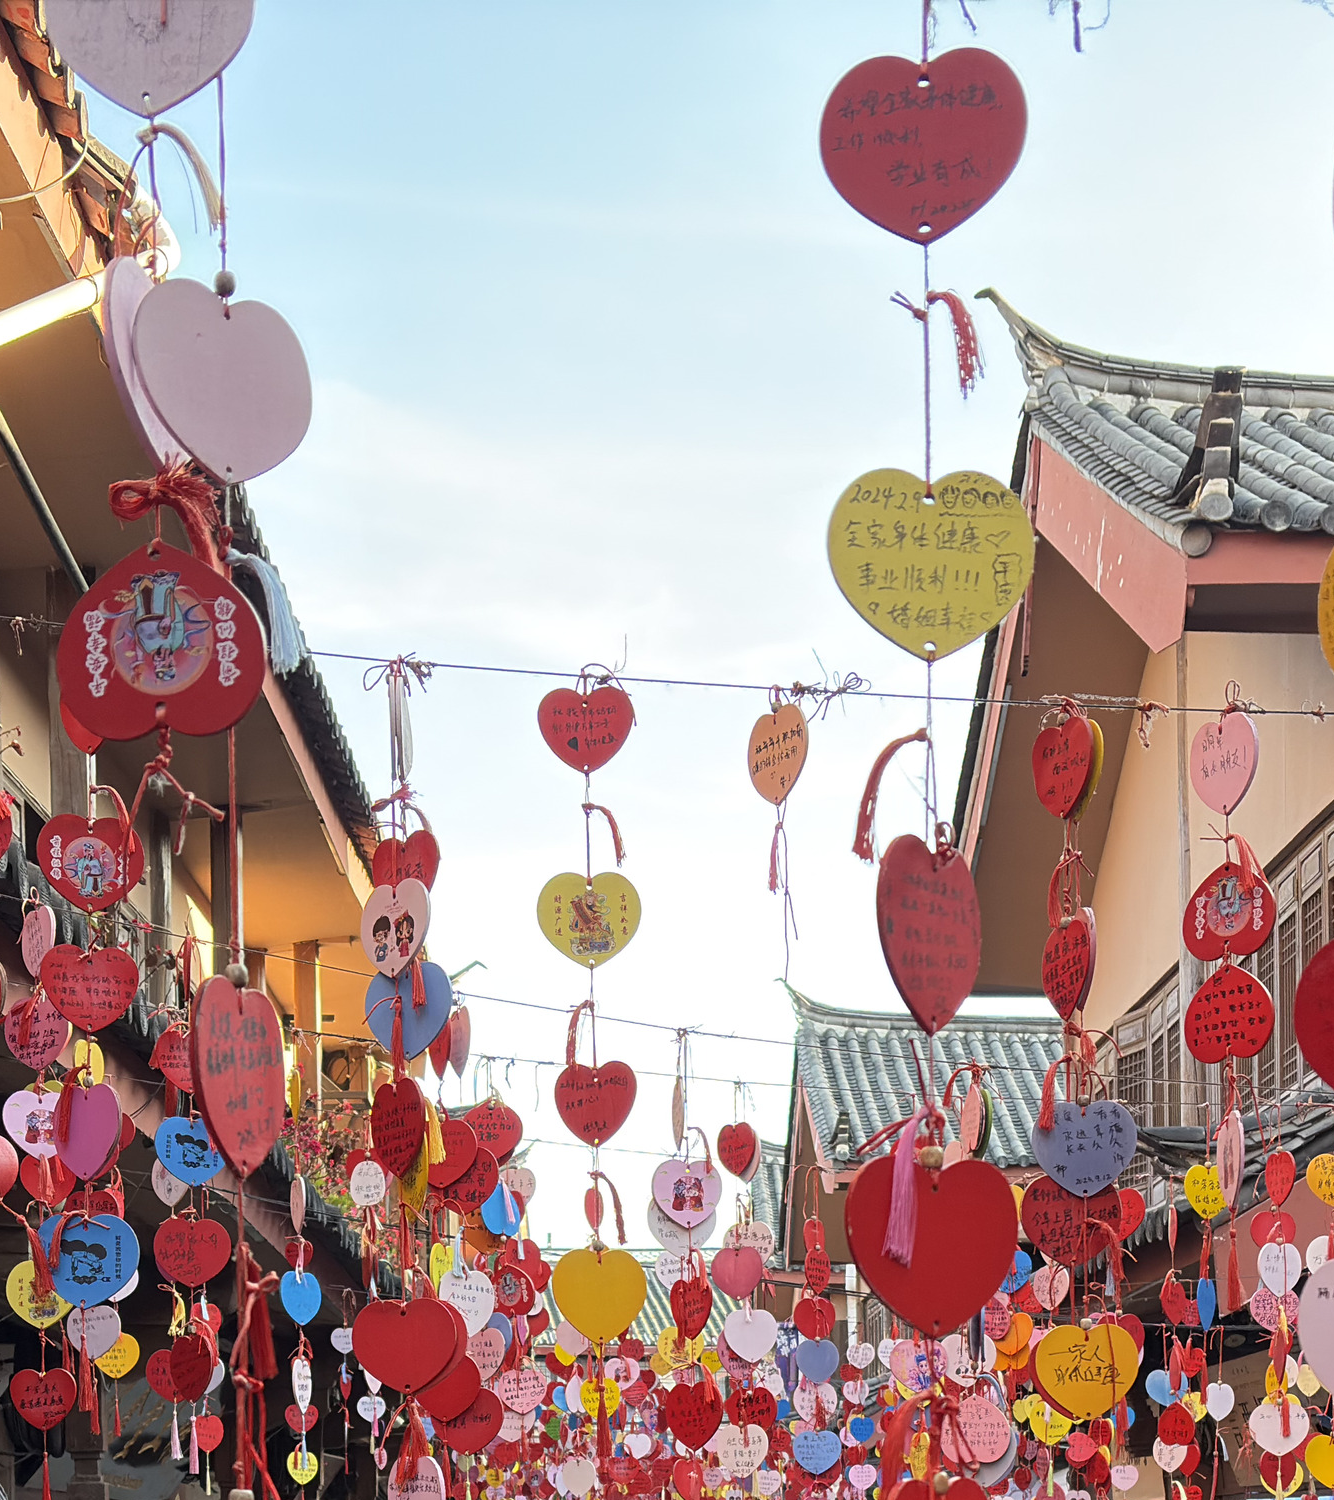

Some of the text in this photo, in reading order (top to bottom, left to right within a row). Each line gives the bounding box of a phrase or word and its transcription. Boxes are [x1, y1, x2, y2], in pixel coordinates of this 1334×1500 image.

[553, 894, 564, 937] 财源广进
[619, 893, 630, 936] 吉祥如意
